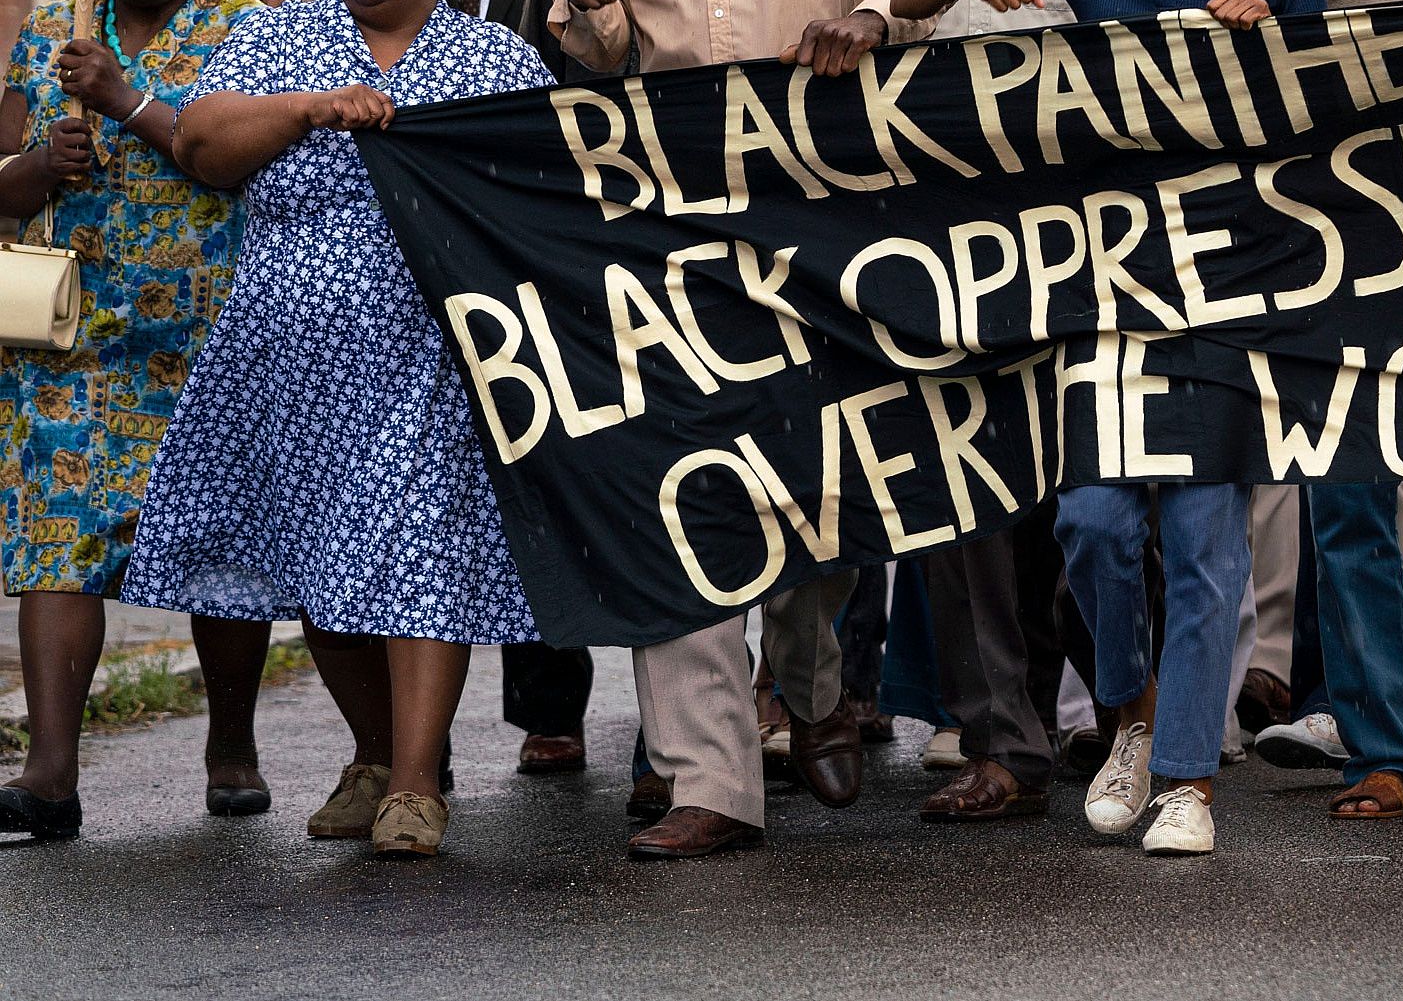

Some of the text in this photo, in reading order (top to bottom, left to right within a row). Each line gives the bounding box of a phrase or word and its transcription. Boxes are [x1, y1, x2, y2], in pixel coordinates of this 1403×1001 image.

[550, 47, 981, 221] BLACK
[445, 240, 811, 466] BLACK
[658, 379, 1019, 607] OVER
[998, 330, 1194, 506] THE
